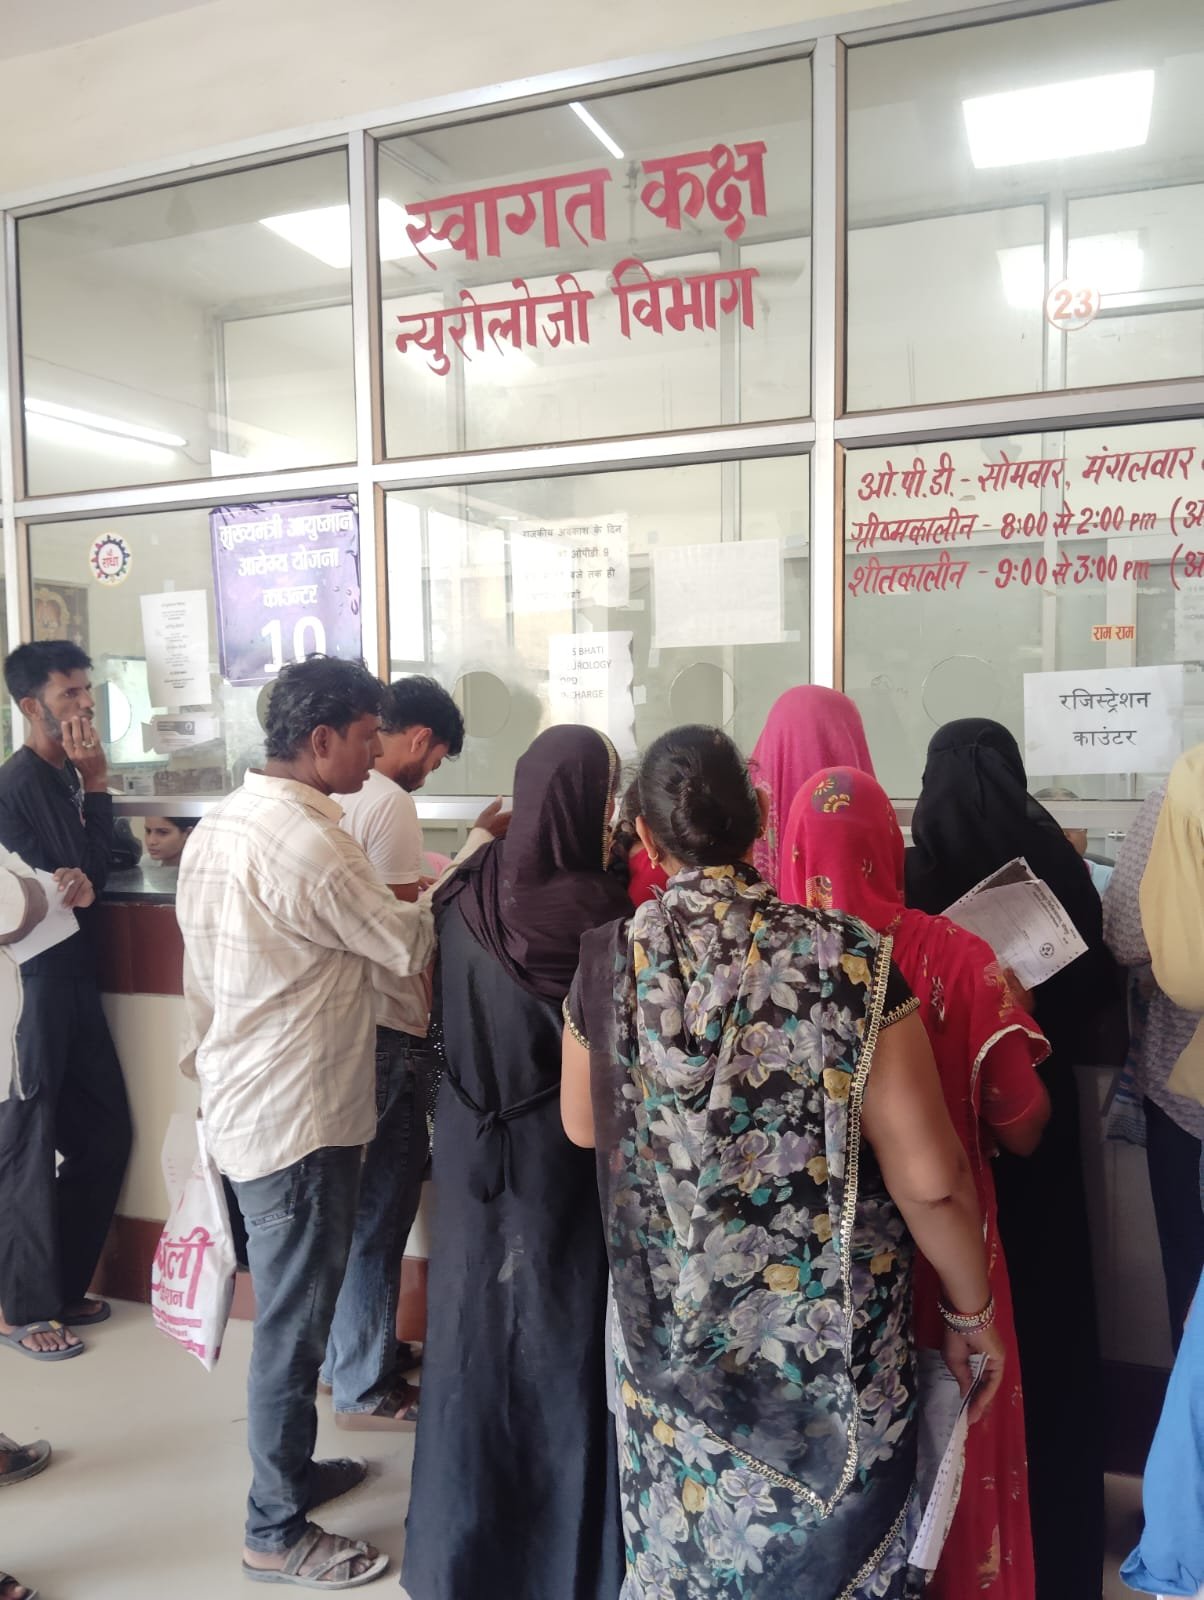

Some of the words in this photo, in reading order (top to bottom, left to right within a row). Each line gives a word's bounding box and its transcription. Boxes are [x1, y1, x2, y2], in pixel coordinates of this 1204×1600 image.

[405, 168, 613, 271] स्वागत
[640, 141, 768, 242] कक्ष
[610, 258, 760, 341] विभाग
[1053, 288, 1093, 320] 23
[1082, 445, 1196, 485] मंगलवार
[607, 522, 622, 535] दिन
[851, 507, 980, 553] ग्रीष्मकालीन
[1000, 511, 1048, 540] 8:00
[1053, 500, 1075, 537] से
[1077, 505, 1124, 535] 2:00
[292, 544, 339, 571] योजना
[848, 549, 971, 597] शीतकालीन
[995, 556, 1048, 589] 9:00
[1052, 550, 1072, 585] से
[1073, 554, 1118, 584] 3:00
[261, 616, 327, 672] 10
[1093, 625, 1112, 640] राम
[1115, 625, 1134, 640] राम
[578, 646, 604, 656] BHATI
[1059, 687, 1151, 713] रजिस्ट्रेशन
[1072, 726, 1138, 747] काउंटर
